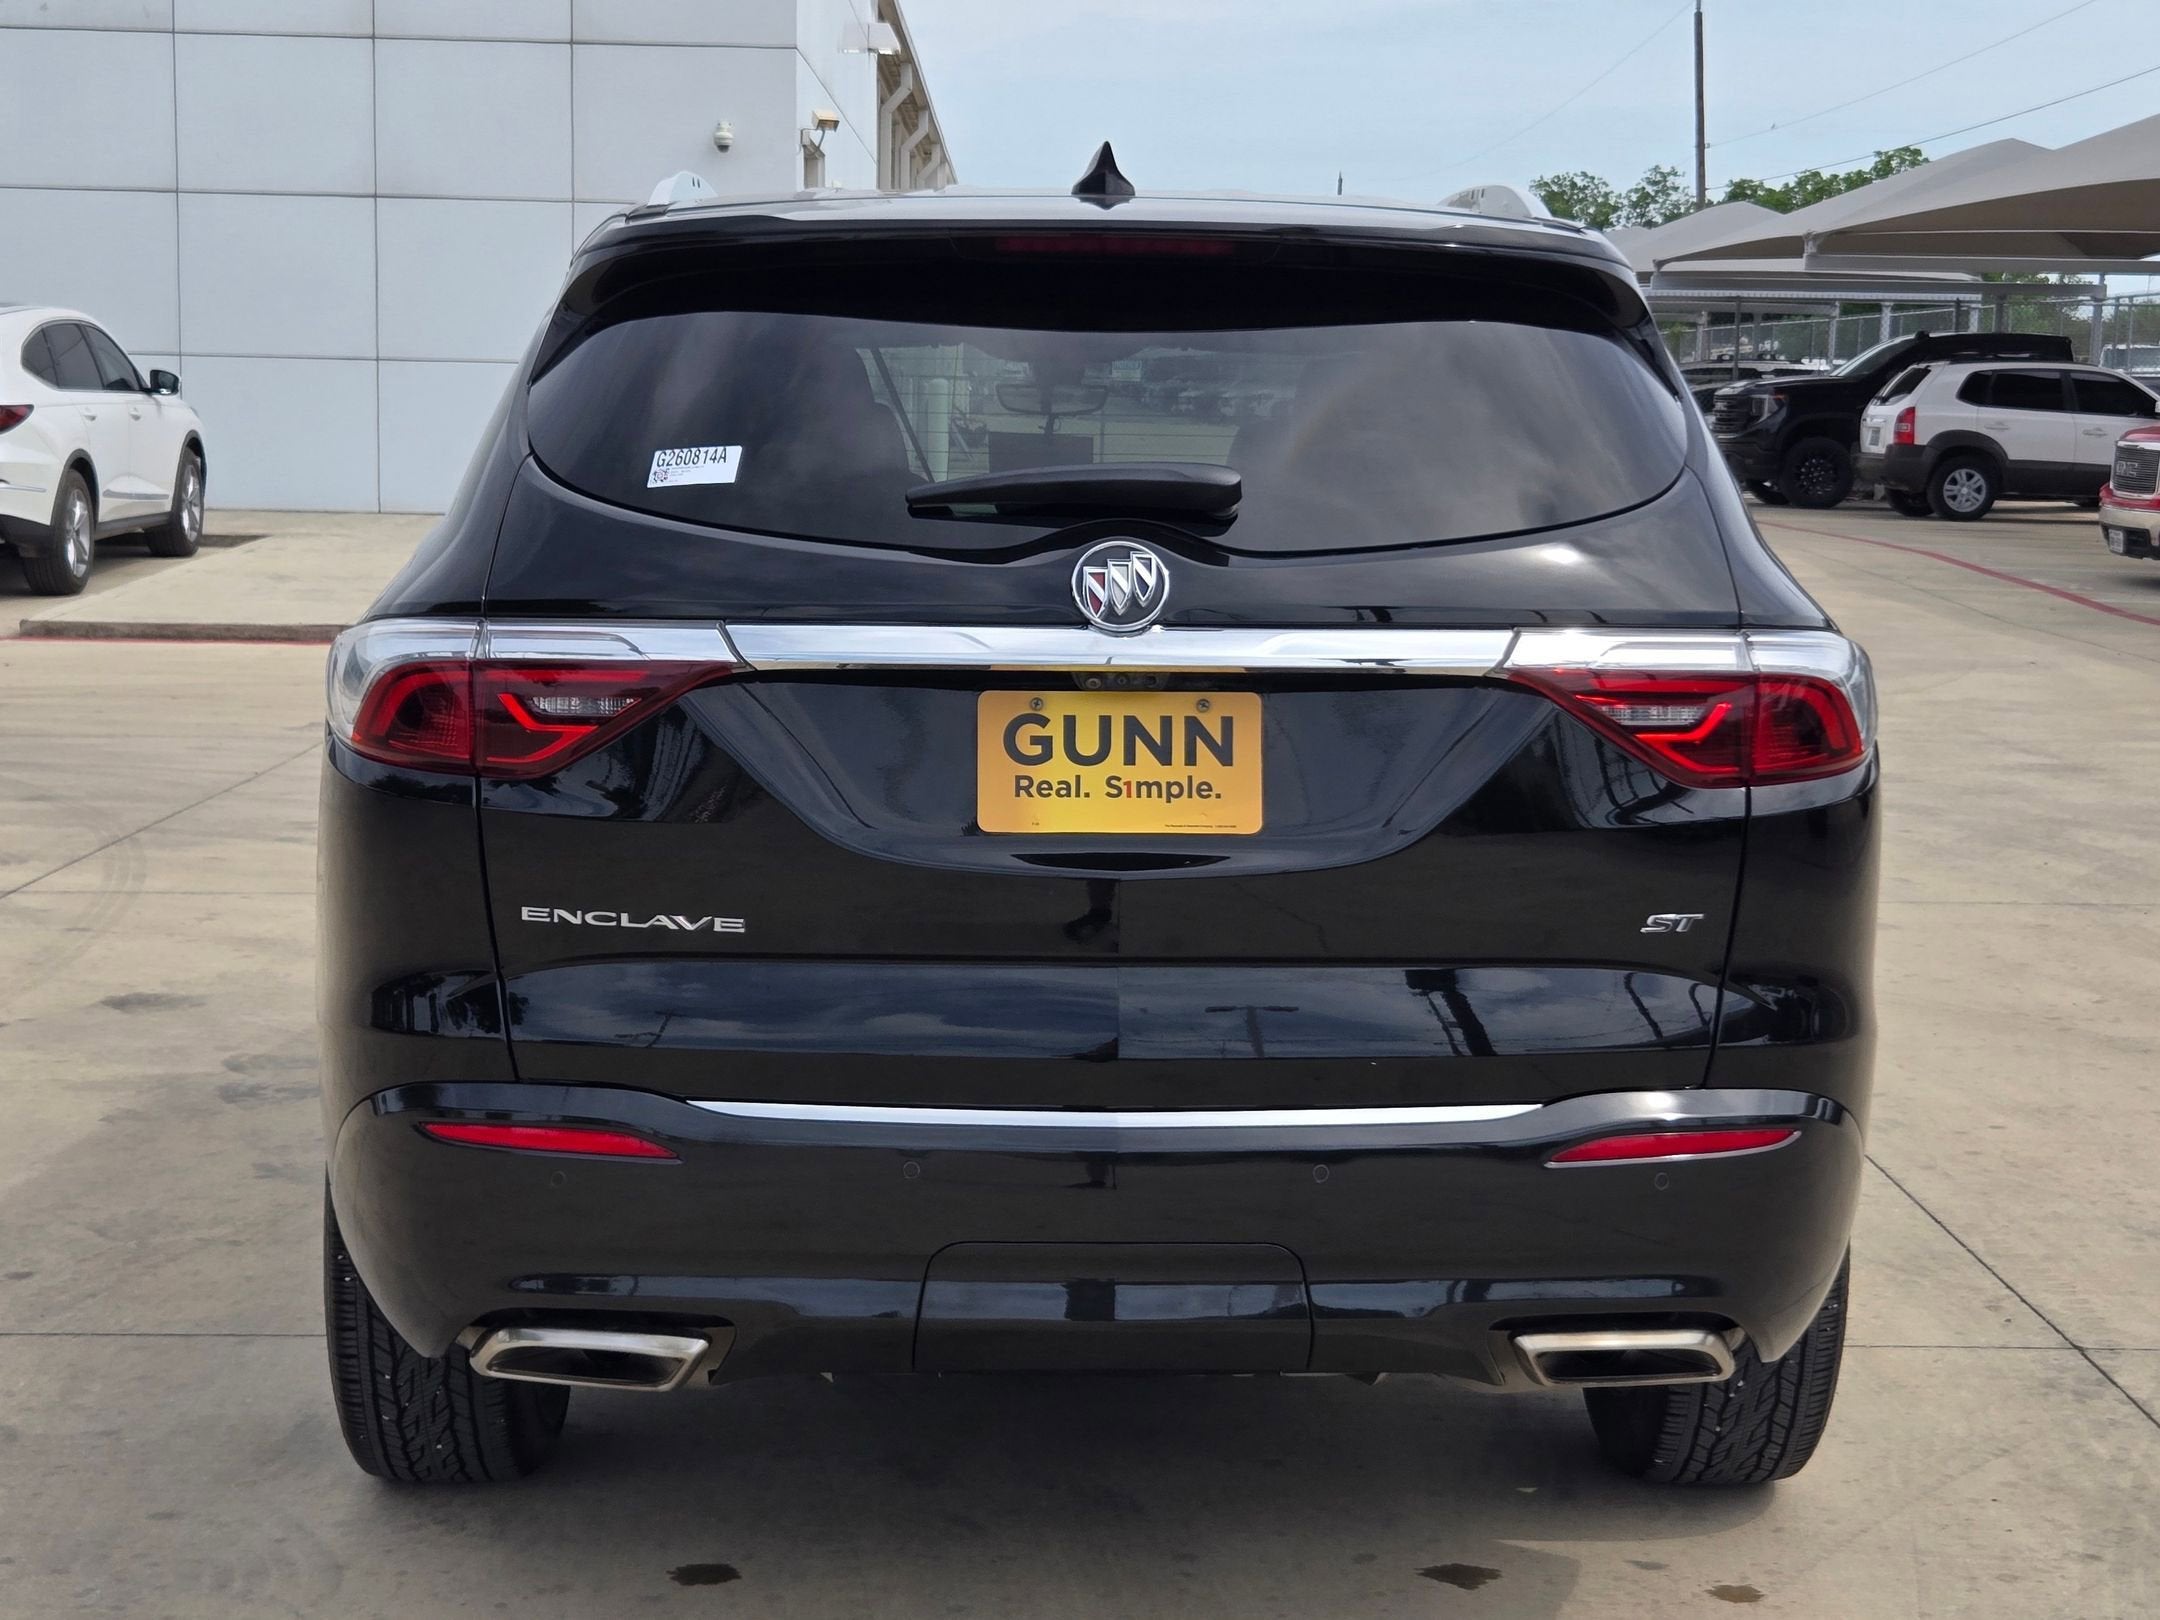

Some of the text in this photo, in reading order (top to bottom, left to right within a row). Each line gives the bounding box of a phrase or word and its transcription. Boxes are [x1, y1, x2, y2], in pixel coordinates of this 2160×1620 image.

[656, 447, 727, 468] G260814A
[1002, 712, 1234, 767] GUNN
[1014, 774, 1091, 798] Real.
[521, 906, 746, 933] ENCLAVE
[1639, 913, 1705, 933] ST
